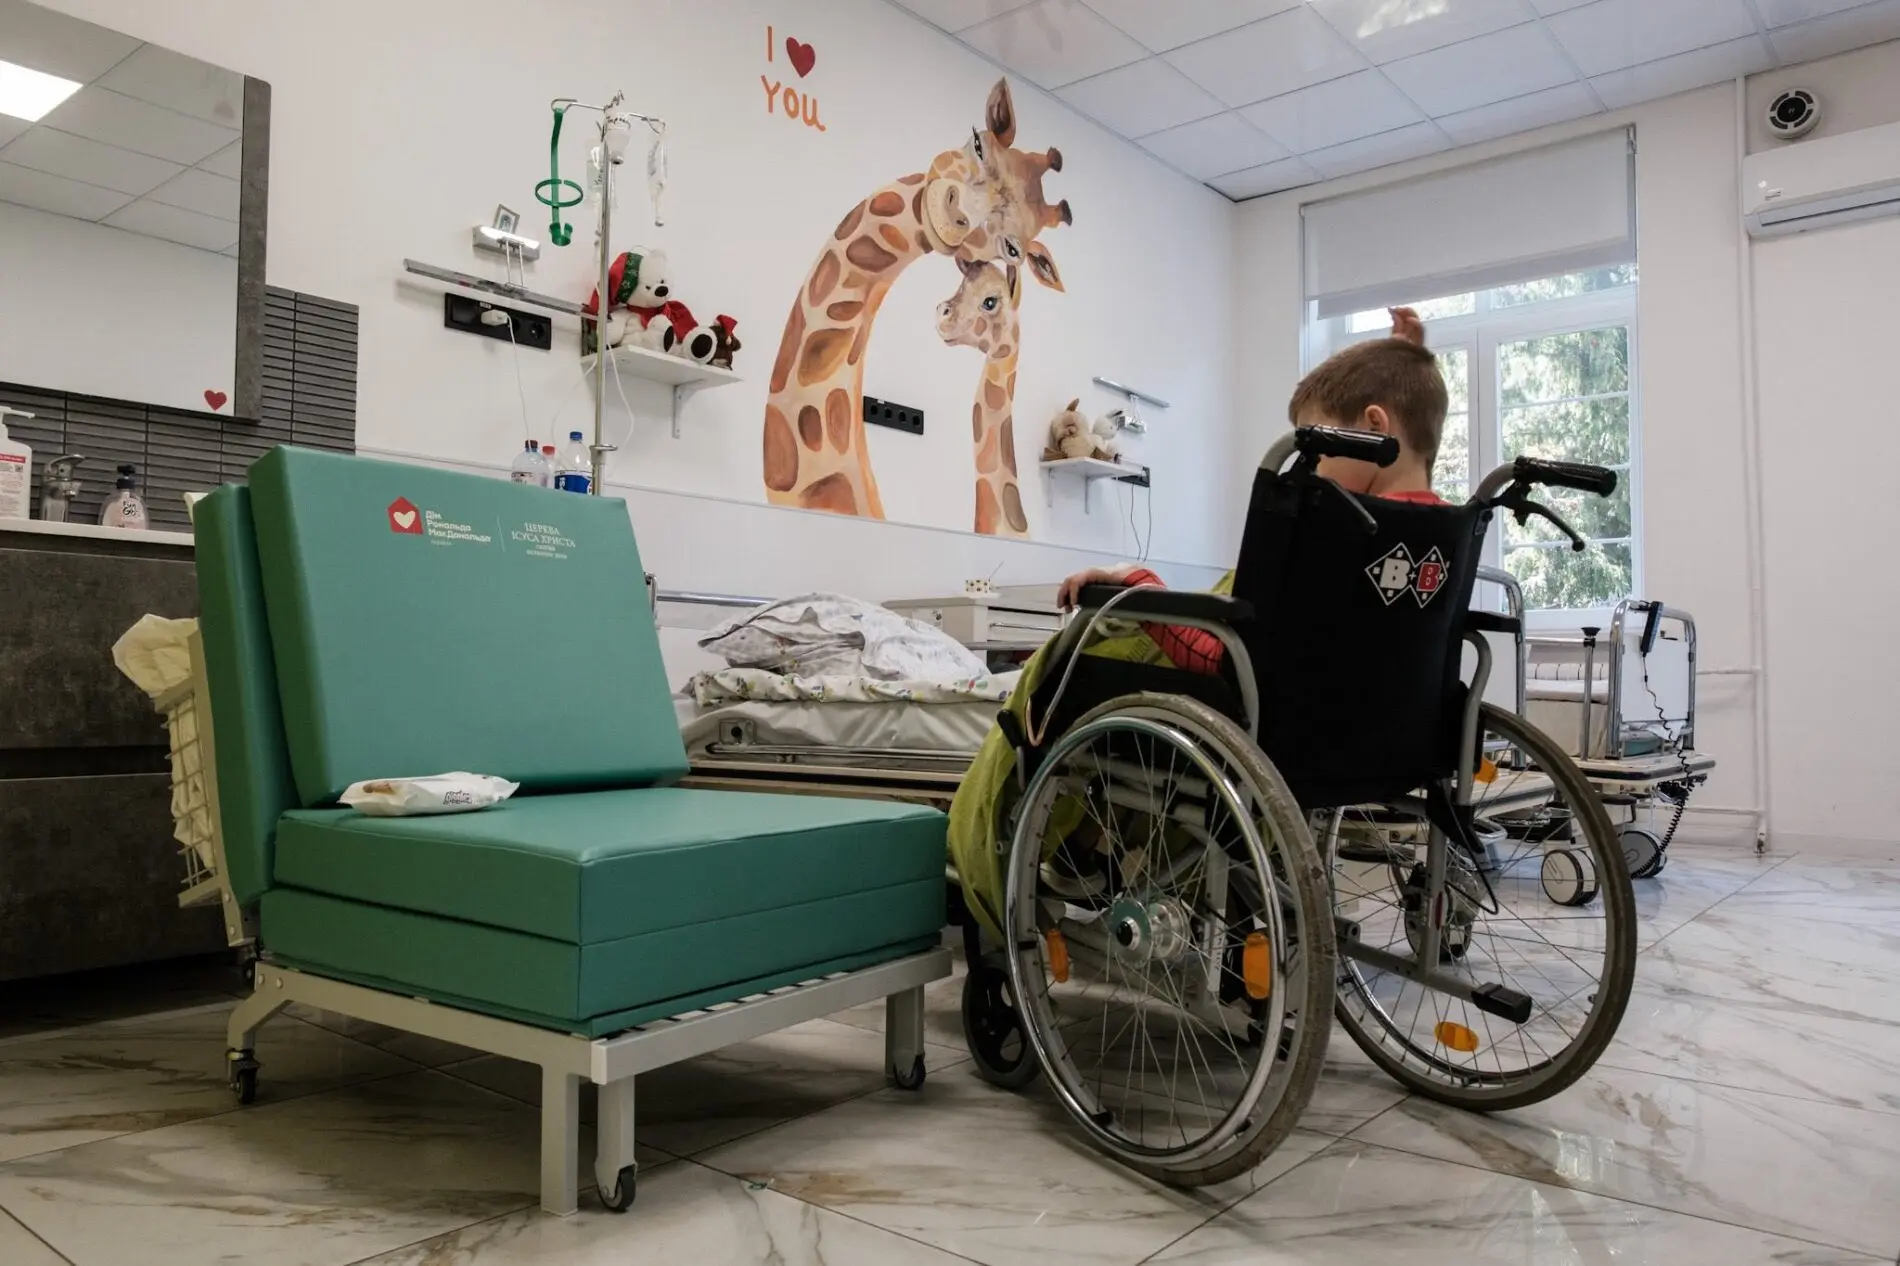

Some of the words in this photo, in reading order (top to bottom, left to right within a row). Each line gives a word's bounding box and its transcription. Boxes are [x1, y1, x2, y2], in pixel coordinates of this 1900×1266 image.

[767, 25, 773, 63] I
[426, 510, 442, 520] Дім
[524, 522, 560, 536] ЦЕРКВА
[540, 535, 576, 548] ХРИСТА
